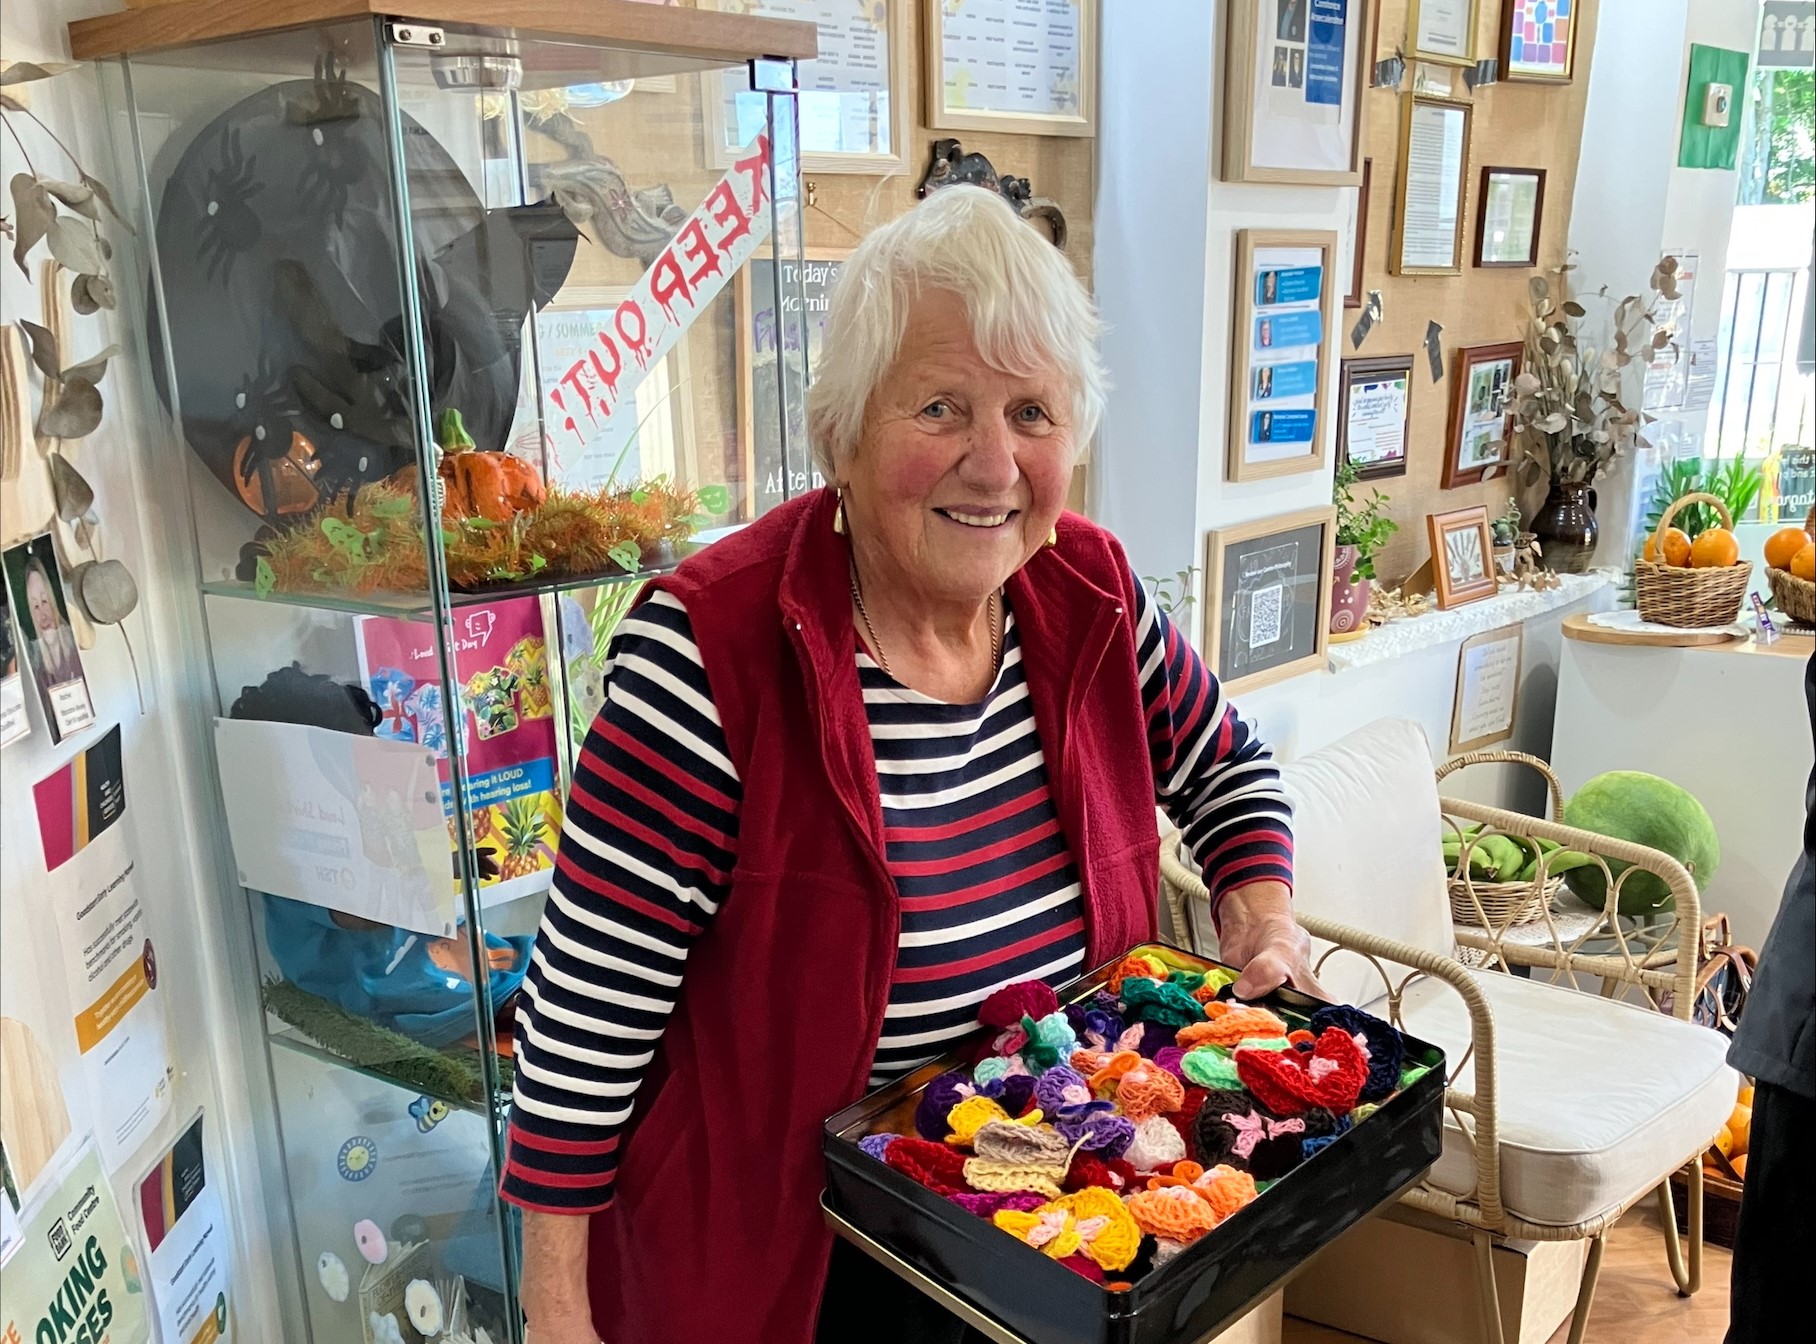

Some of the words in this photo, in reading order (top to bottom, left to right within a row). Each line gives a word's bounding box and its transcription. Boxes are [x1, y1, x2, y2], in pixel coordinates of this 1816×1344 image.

[783, 262, 838, 287] Today's
[461, 638, 478, 650] Day
[499, 768, 524, 782] LOUD
[480, 785, 512, 802] hearing
[512, 779, 532, 791] loss!
[36, 1235, 108, 1344] OKING
[71, 1288, 113, 1344] SES
